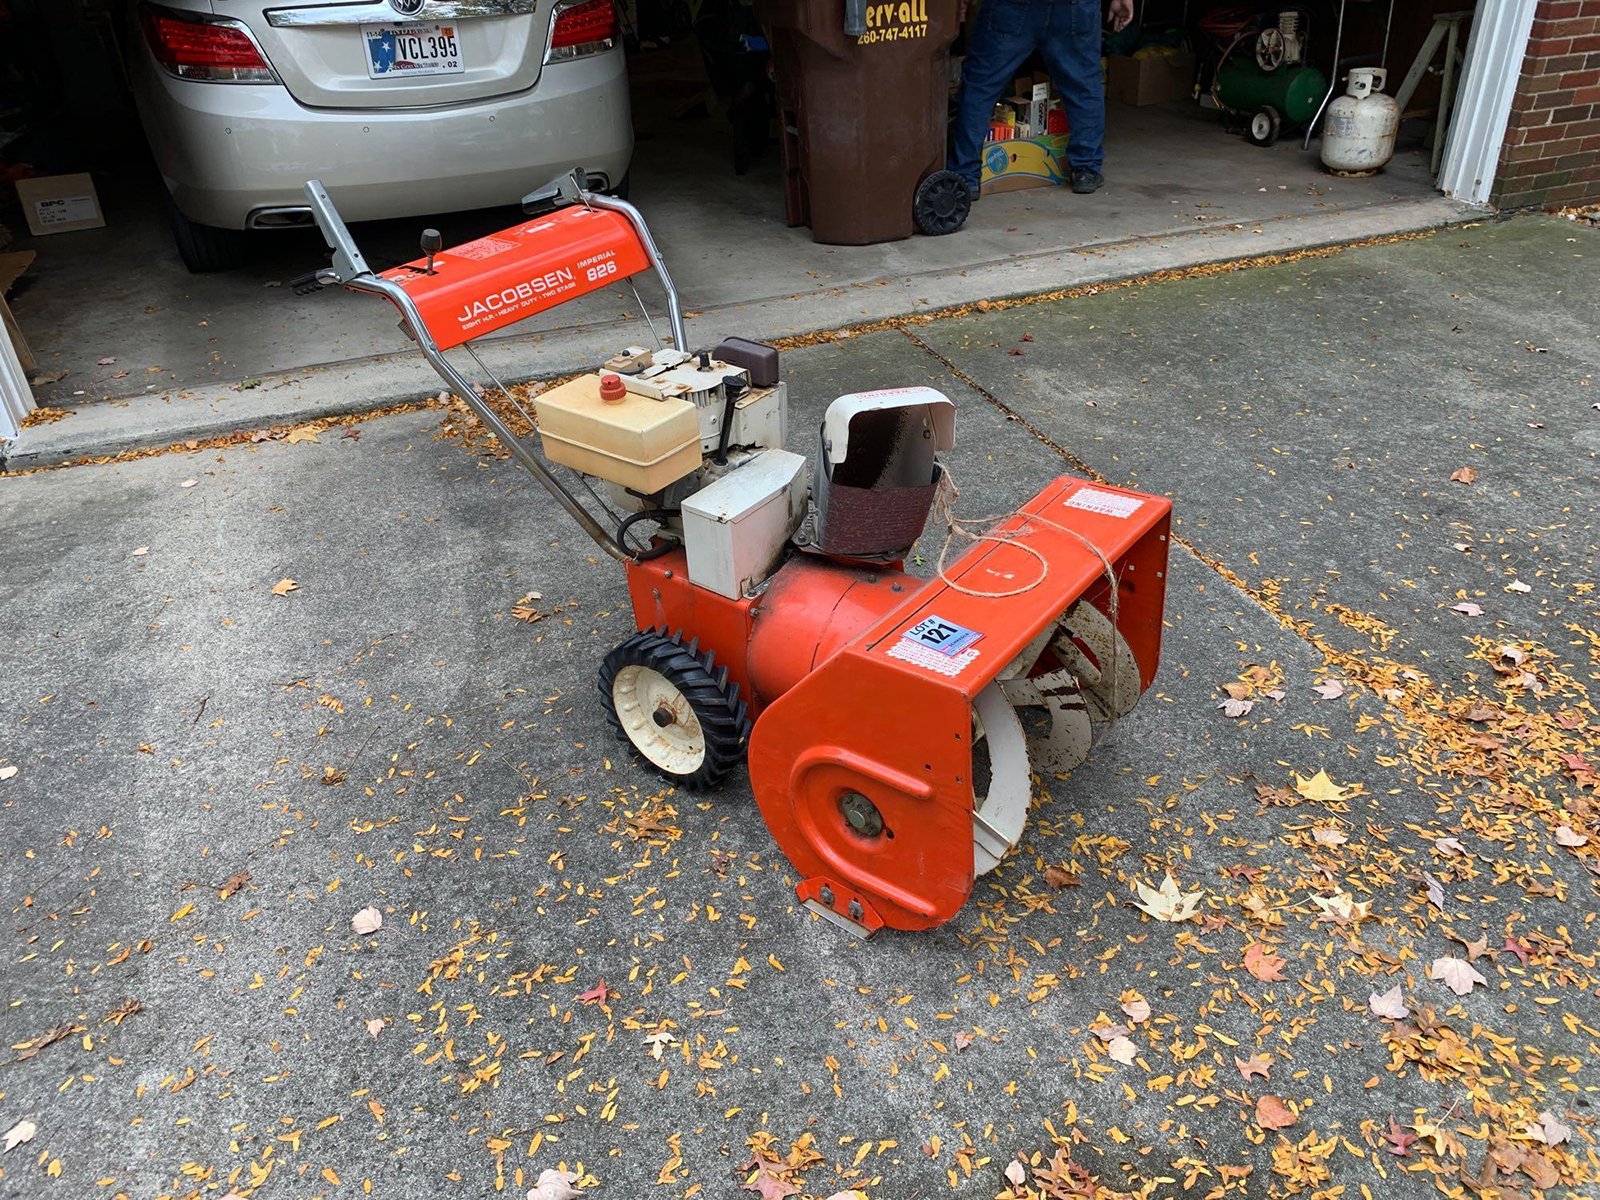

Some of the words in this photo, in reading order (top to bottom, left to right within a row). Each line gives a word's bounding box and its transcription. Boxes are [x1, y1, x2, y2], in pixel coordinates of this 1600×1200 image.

[857, 24, 928, 45] 260-747-4117
[398, 36, 458, 60] VCL395
[447, 60, 458, 68] 02
[577, 250, 617, 269] IMPERIAL
[586, 261, 617, 282] 826
[457, 266, 574, 322] JACOBSEN
[462, 318, 482, 330] EIGHT
[497, 304, 519, 317] HEAVY
[520, 297, 539, 308] DUTY
[542, 290, 556, 299] TWO
[556, 282, 577, 294] STAGE
[909, 622, 929, 636] LOT
[920, 623, 958, 645] 121
